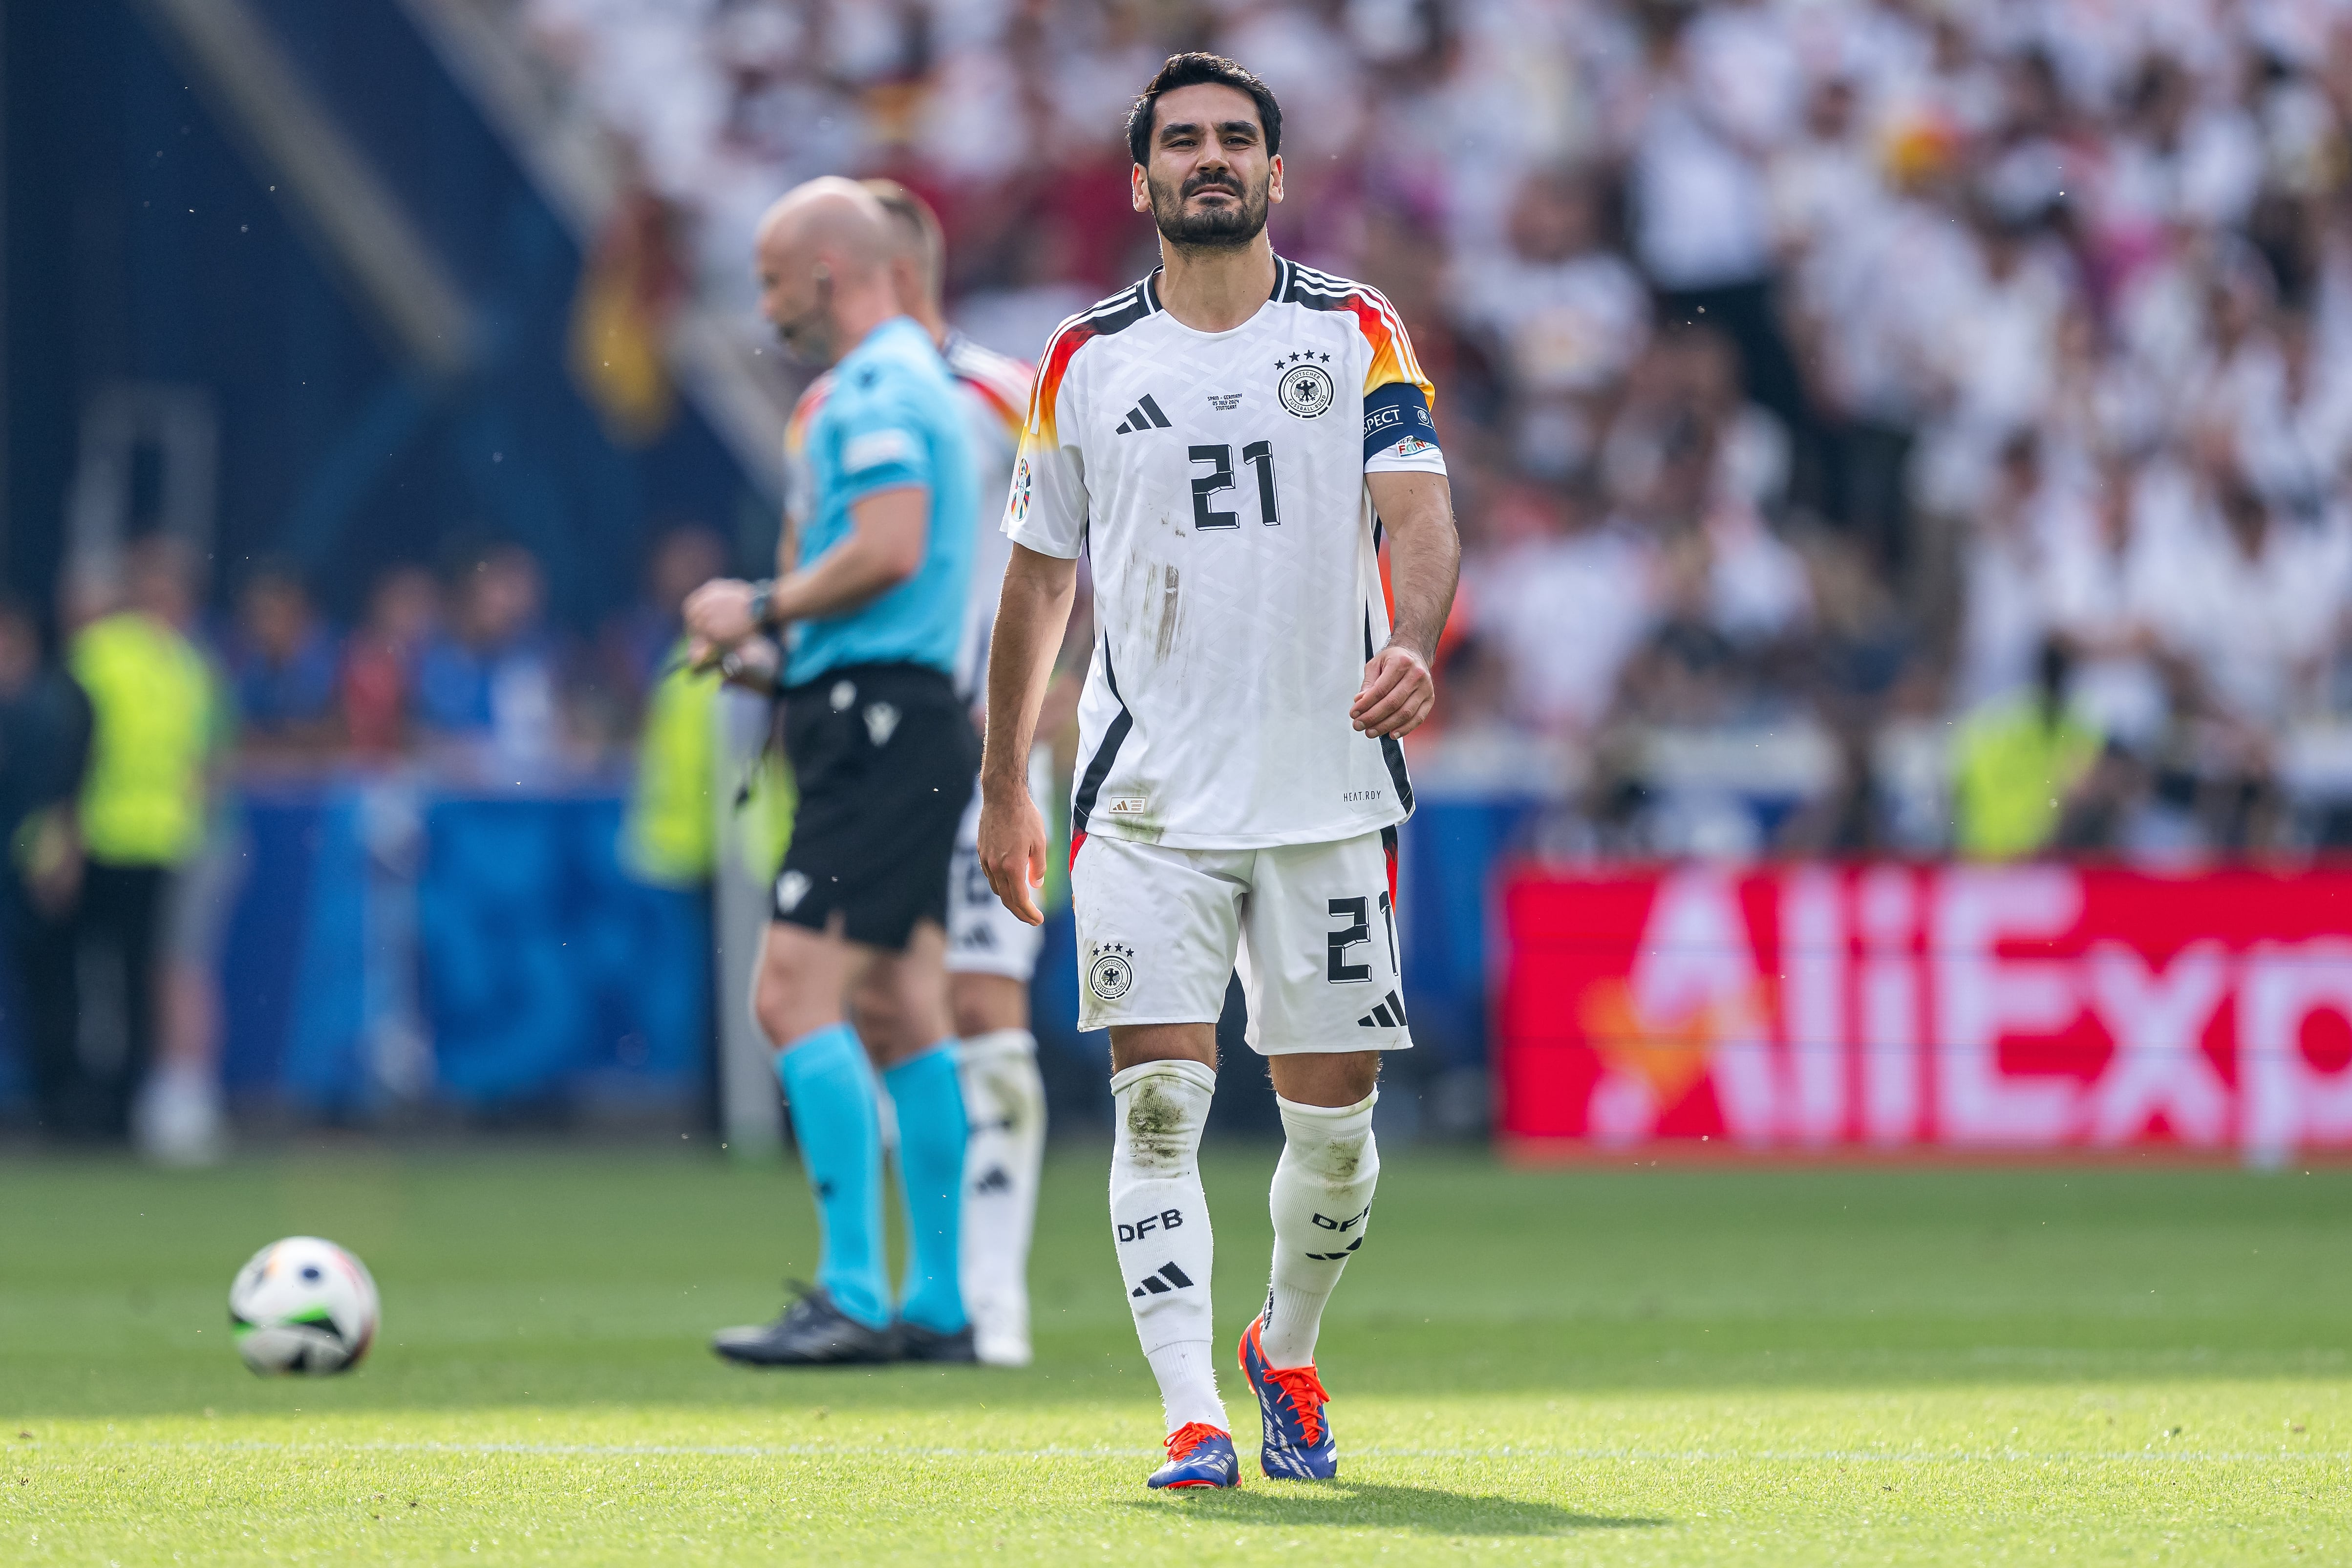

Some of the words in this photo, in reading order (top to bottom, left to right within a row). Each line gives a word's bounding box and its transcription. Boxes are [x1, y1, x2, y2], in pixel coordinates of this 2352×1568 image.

[1289, 371, 1320, 383] DEUTSCHER
[1287, 394, 1326, 411] FUSSBALL-BUND
[1188, 440, 1281, 531] 21
[1344, 790, 1381, 802] HEAT.RDY
[1327, 890, 1399, 984] 21
[1100, 961, 1124, 969] DEUTSCHER
[1096, 982, 1125, 993] FUSSBALL-BUND
[1312, 1199, 1372, 1232] DF
[1117, 1208, 1183, 1242] DFB
